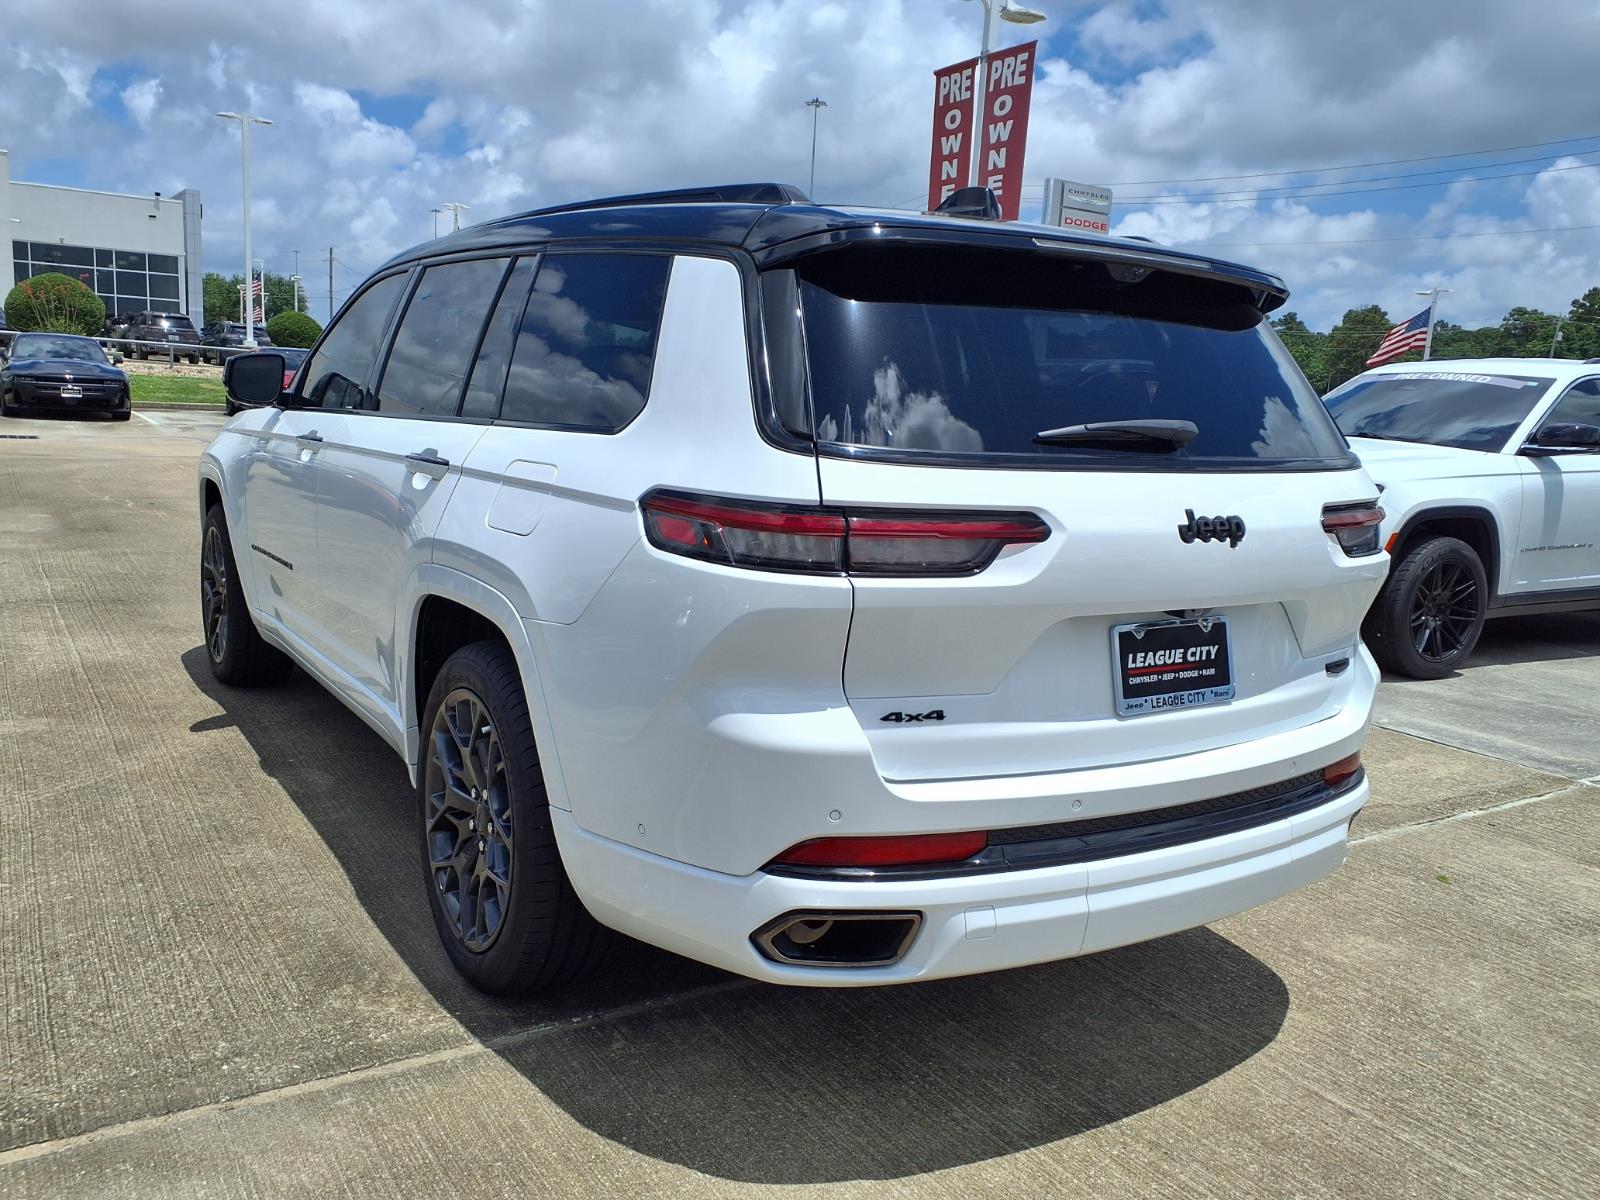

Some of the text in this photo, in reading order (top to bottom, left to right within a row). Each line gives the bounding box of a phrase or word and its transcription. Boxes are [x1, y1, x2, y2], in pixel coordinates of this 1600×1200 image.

[989, 52, 1029, 92] PRE
[939, 68, 973, 106] PRE
[940, 109, 963, 204] OWNE
[987, 95, 1013, 218] OWNE
[1068, 188, 1109, 200] CHRYSLER
[1064, 217, 1107, 231] DODGE
[1178, 508, 1246, 548] Jeep
[1128, 645, 1219, 668] LEAGUE CITY
[1129, 668, 1216, 685] CHRYSLER JEEP DODGE RAM
[1125, 703, 1144, 711] Jeep
[1151, 695, 1185, 709] LEAGUE
[1187, 691, 1206, 704] CITY
[880, 709, 946, 723] 4x4
